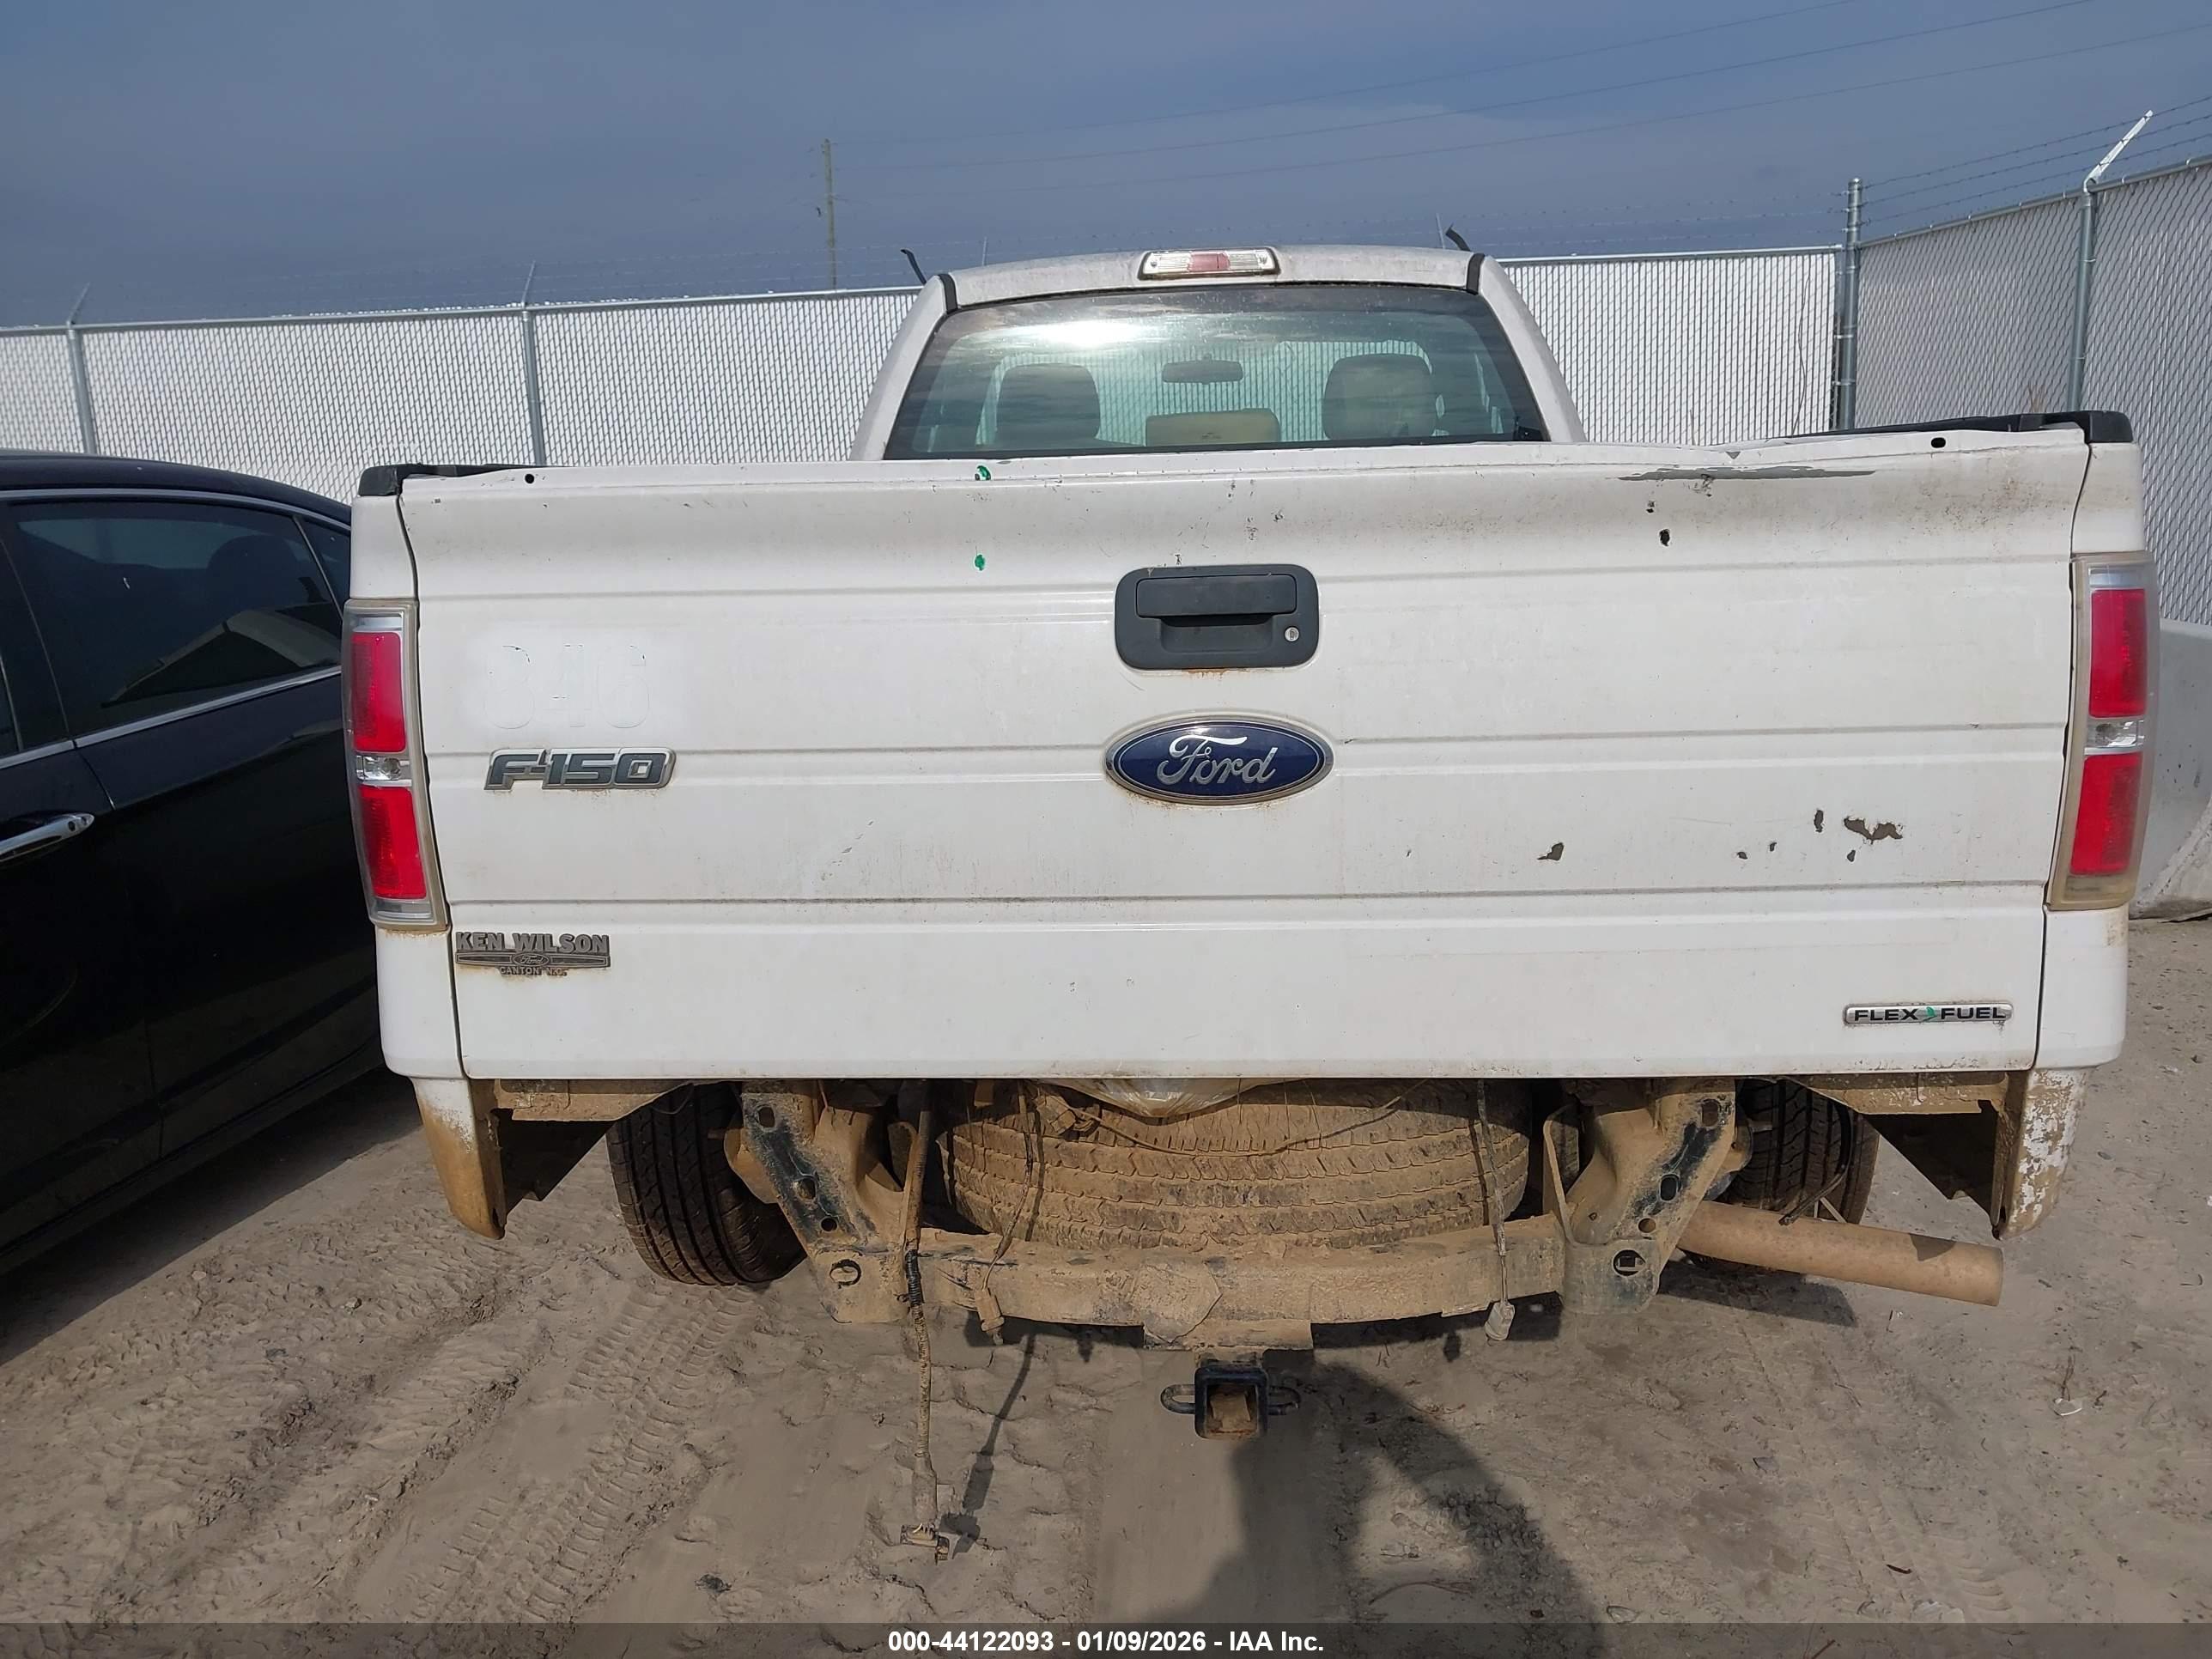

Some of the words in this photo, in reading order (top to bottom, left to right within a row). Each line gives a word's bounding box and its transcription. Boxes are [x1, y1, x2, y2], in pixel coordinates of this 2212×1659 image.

[483, 747, 677, 790] F-150
[1157, 734, 1279, 785] Ford
[456, 932, 505, 951] KEN
[513, 933, 610, 954] WILSON
[520, 954, 544, 964] Ford
[1854, 1008, 1919, 1022] FLEX
[1941, 1006, 2007, 1020] FUEL
